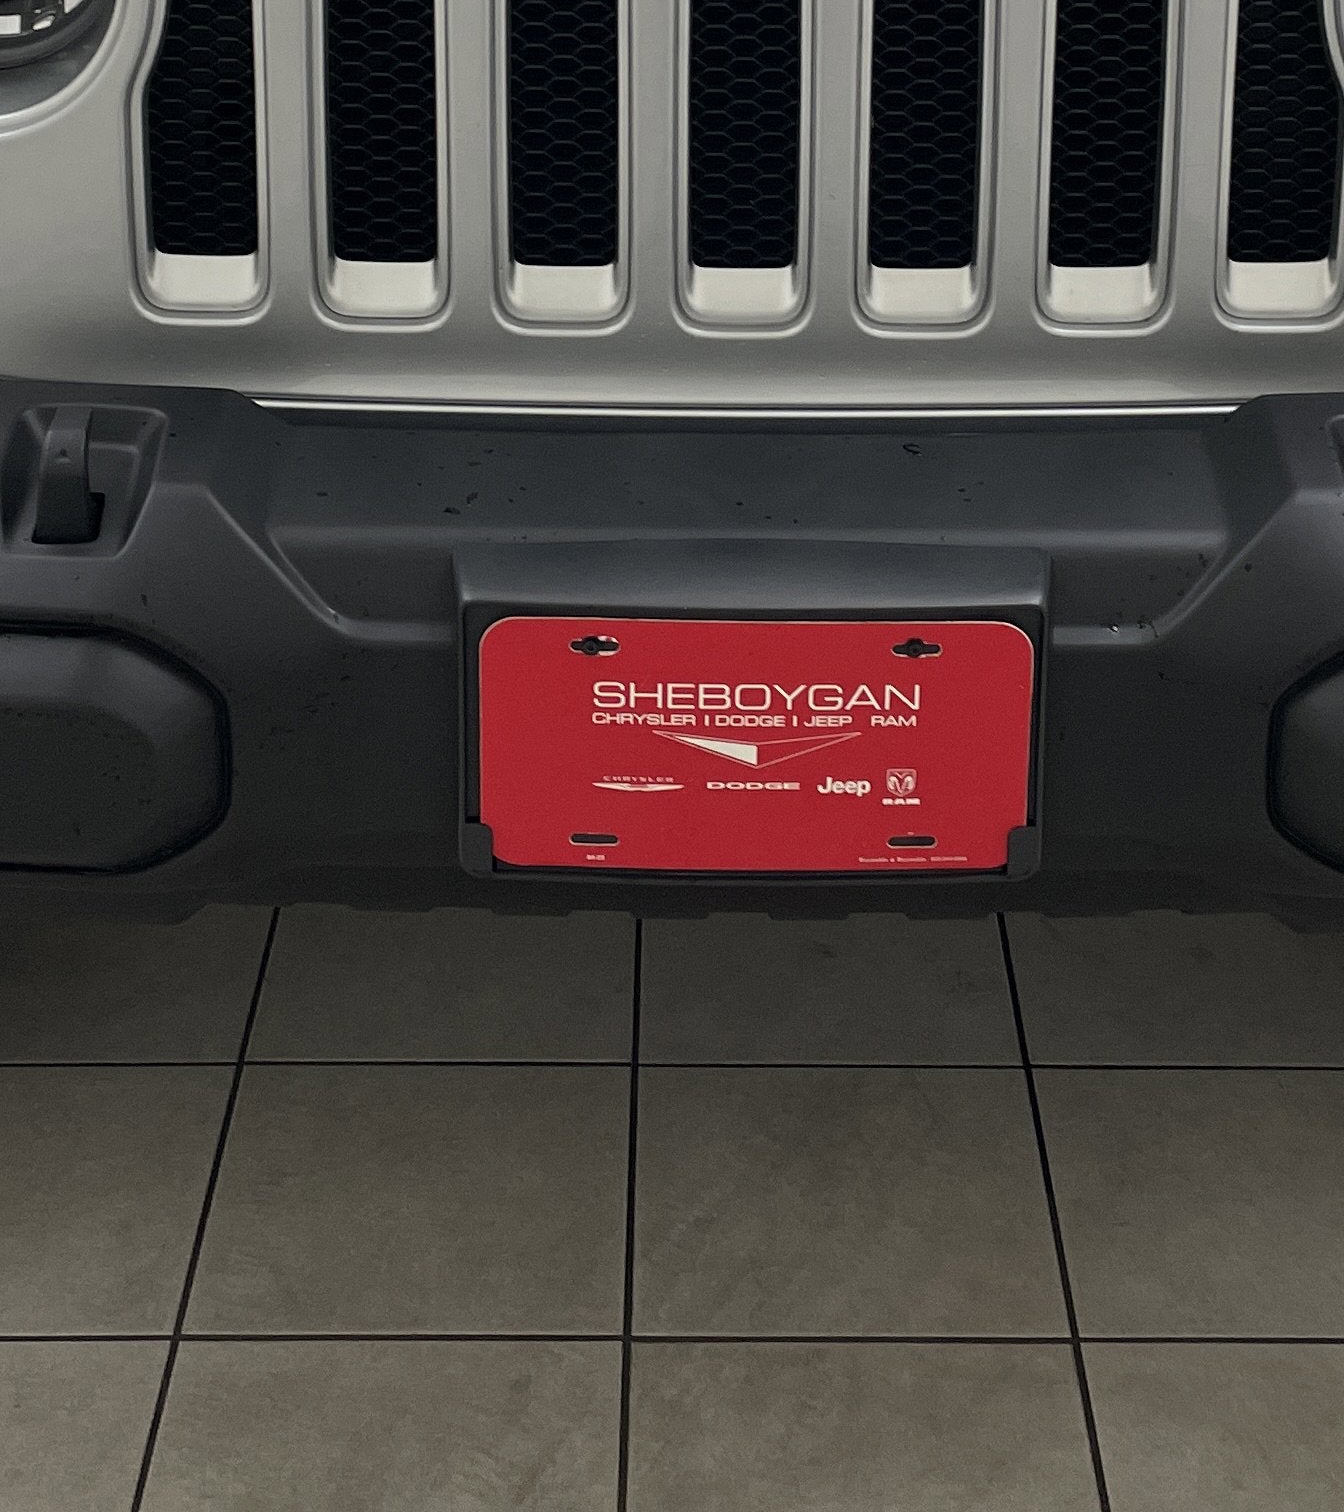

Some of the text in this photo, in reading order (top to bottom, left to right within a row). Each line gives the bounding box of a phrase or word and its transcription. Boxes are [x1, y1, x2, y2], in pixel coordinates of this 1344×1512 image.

[592, 681, 922, 711] SHEBOYGAN
[591, 712, 697, 727] CHRYSLER
[714, 715, 786, 727] DODGE
[803, 715, 853, 727] JEEP
[870, 715, 918, 727] RAM
[602, 775, 872, 797] CHRYSLER DODGE Jeep
[881, 797, 922, 806] RAM
